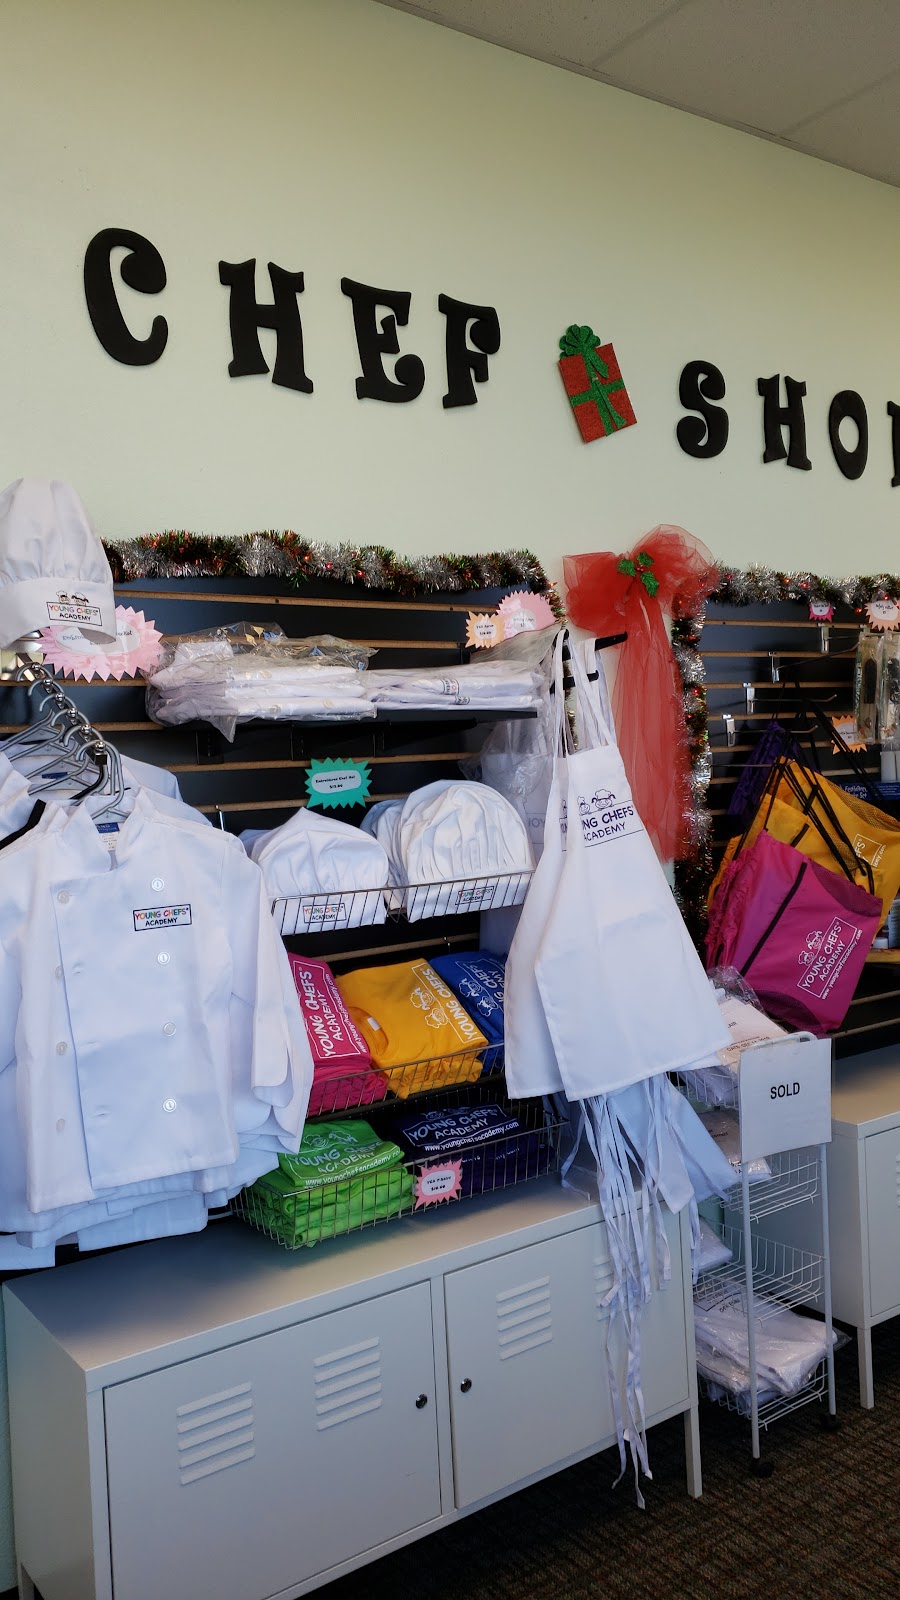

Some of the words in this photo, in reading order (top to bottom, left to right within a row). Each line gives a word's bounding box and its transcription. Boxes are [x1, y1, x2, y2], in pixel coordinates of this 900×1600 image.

[84, 227, 502, 410] CHEF
[676, 360, 900, 487] SHO
[48, 604, 75, 613] YOUNG
[76, 607, 98, 616] CHEFS
[59, 612, 92, 622] ACADEMY
[601, 805, 634, 824] CHEFS
[134, 909, 162, 921] YOUNG
[163, 907, 188, 918] CHEFS
[145, 916, 178, 927] ACADEMY
[802, 955, 827, 988] YOUNG
[824, 924, 842, 955] CHEFS
[819, 939, 846, 982] ACADEMY
[300, 971, 320, 1011] CHEFS
[421, 967, 452, 999] CHEFS
[317, 989, 344, 1042] ACADEMY
[445, 999, 478, 1040] YOUNG
[309, 1014, 337, 1058] YOUNG
[770, 1082, 800, 1100] SOLD
[409, 1117, 457, 1141] YOUNG
[434, 1118, 489, 1140] ACADEMY
[288, 1148, 341, 1167] YOUNG
[317, 1151, 375, 1174] ACADEMY
